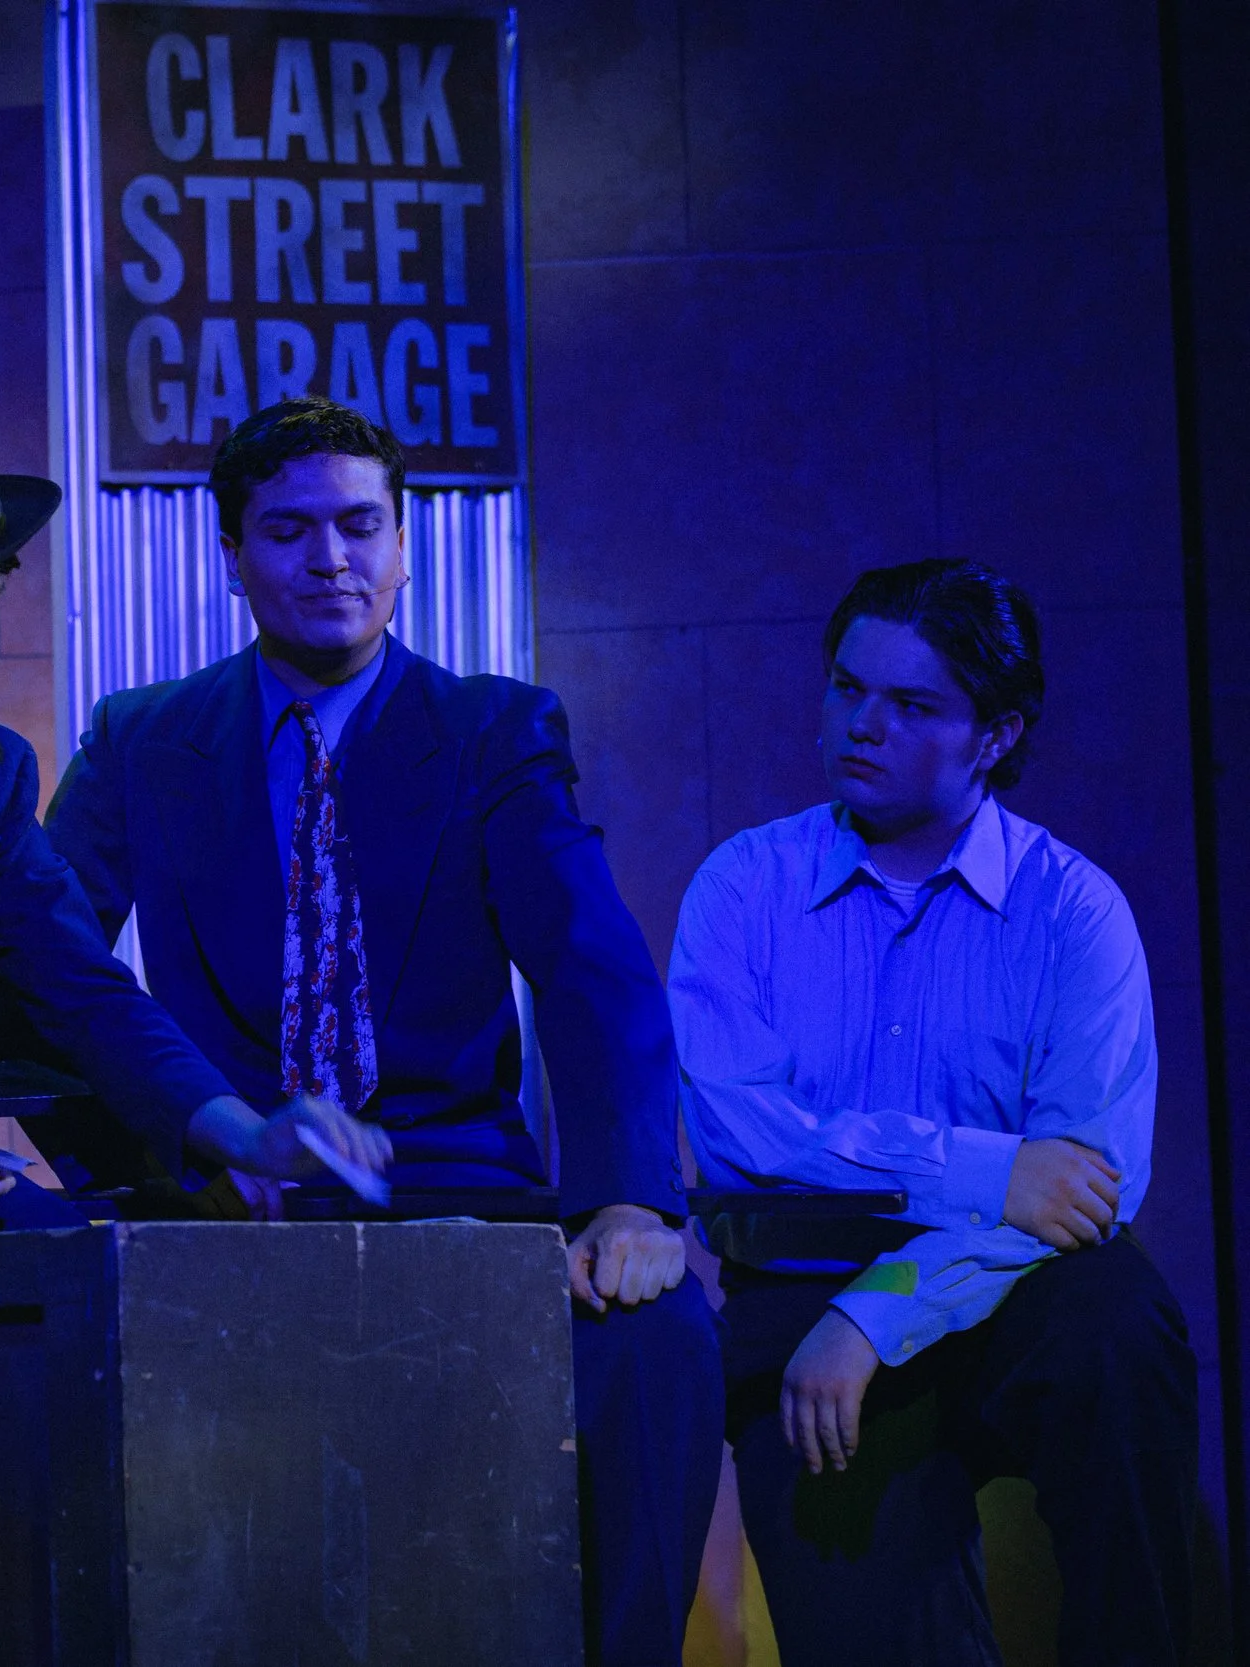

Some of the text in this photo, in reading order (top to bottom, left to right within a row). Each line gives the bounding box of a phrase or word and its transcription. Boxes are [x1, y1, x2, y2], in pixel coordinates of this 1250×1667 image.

[145, 33, 462, 169] CLARK
[120, 174, 485, 306] STREET
[126, 315, 499, 448] GARAGE
